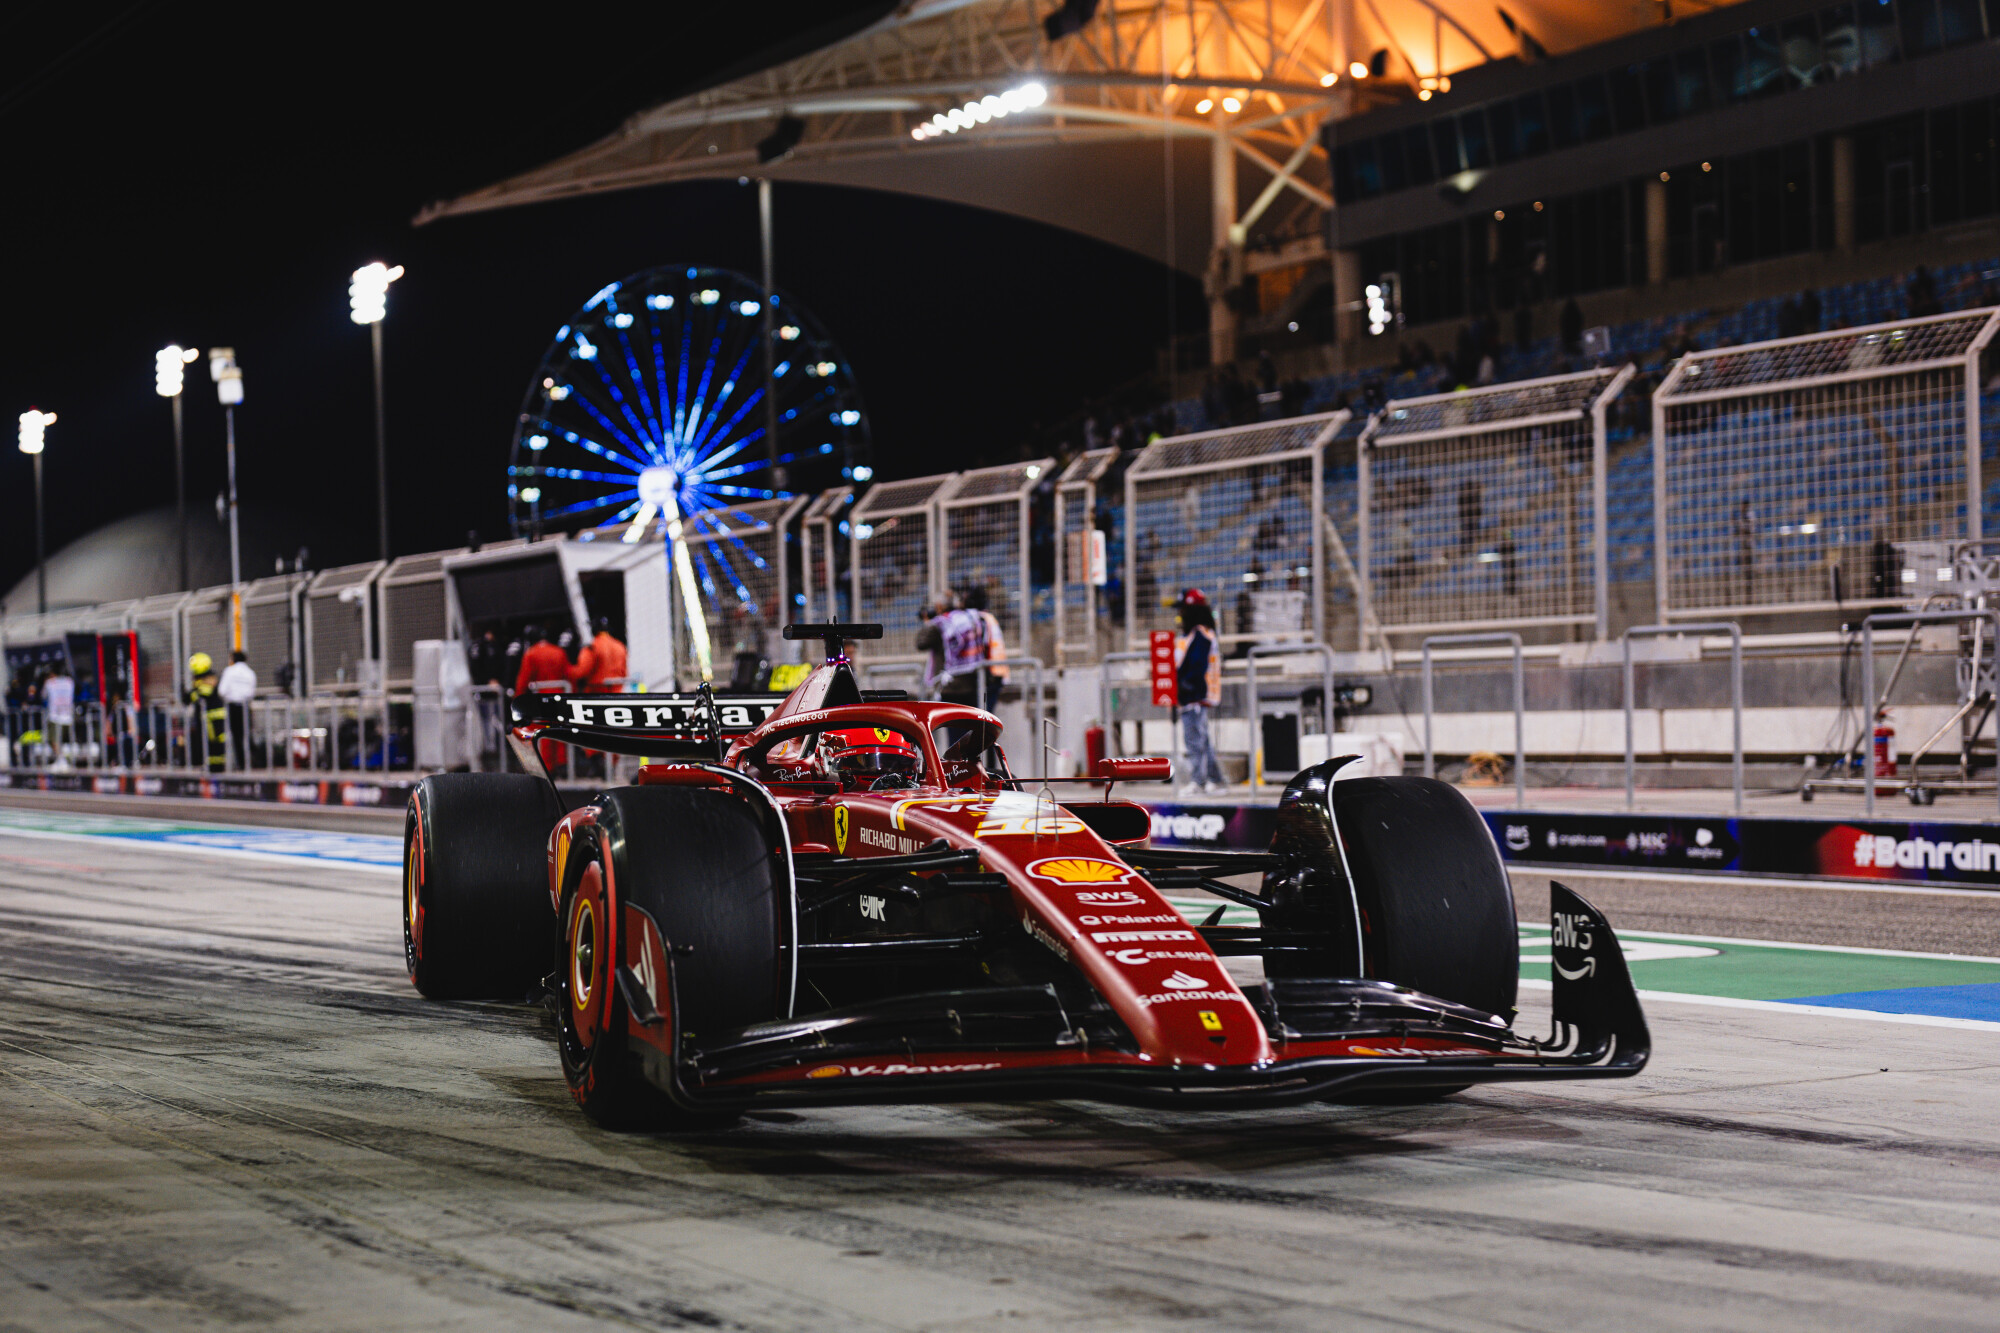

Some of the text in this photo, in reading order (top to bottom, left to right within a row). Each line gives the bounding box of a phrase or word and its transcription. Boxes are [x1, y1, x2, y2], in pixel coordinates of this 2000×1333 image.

[777, 712, 830, 727] TECHNOLOGY
[773, 766, 811, 782] Ray-Ban
[974, 817, 1087, 839] 16
[860, 827, 896, 851] RICHARD
[1853, 833, 2000, 872] #Bahrain
[1075, 891, 1141, 902] aws
[1102, 914, 1178, 924] Palantir
[1090, 930, 1196, 944] PIRELLI
[1553, 911, 1594, 955] aws
[1146, 950, 1213, 961] CELSIUS
[1136, 989, 1247, 1009] Santande
[850, 1063, 1001, 1077] V-Power
